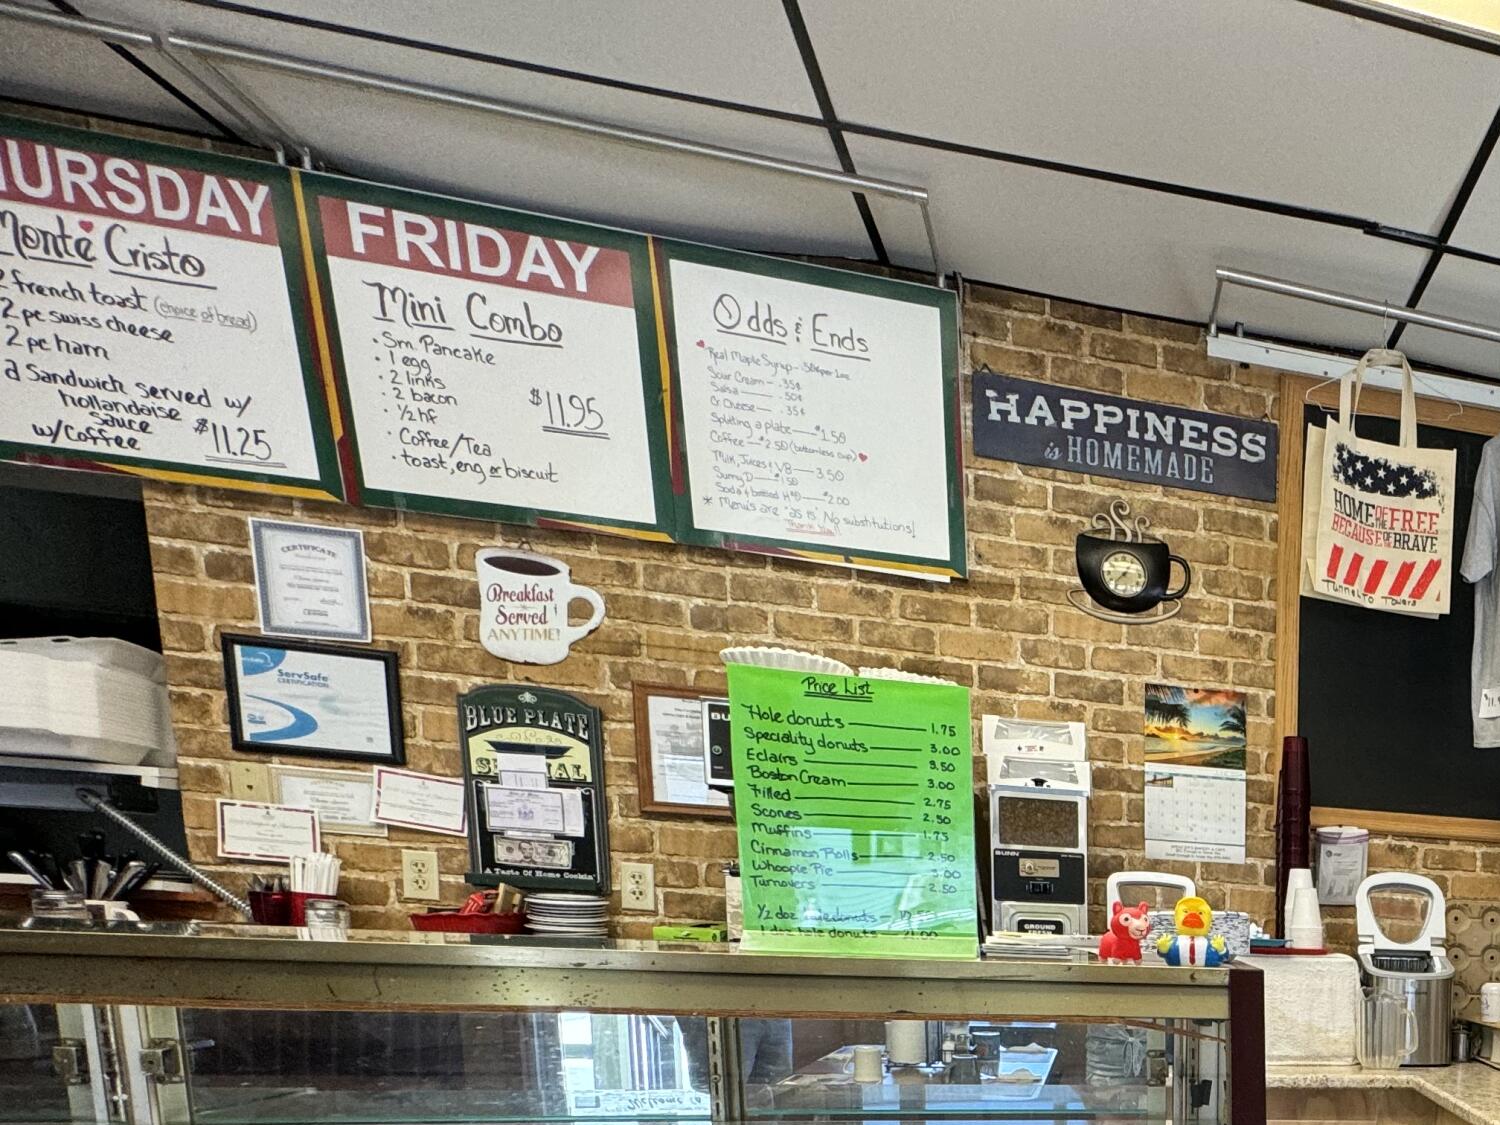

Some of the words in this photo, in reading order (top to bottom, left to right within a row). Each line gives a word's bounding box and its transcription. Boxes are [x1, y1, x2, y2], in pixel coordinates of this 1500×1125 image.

[0, 139, 271, 236] URSDAY
[105, 223, 206, 278] Cristo
[346, 201, 600, 293] FRIDAY
[11, 270, 85, 303] french
[90, 282, 148, 311] toast
[1, 299, 17, 319] 2
[49, 310, 103, 330] swiss
[105, 317, 175, 344] cheese
[362, 280, 446, 327] Mini
[466, 292, 564, 342] Combo
[713, 293, 788, 338] Odds
[811, 313, 870, 353] Ends
[6, 325, 23, 347] 2
[26, 334, 51, 354] pc
[54, 333, 110, 361] ham
[419, 335, 496, 366] Pancake
[401, 355, 432, 376] egg
[708, 366, 731, 380] Sour
[735, 371, 765, 385] Cream
[731, 350, 761, 367] Maple
[761, 354, 792, 376] Syrup
[5, 360, 21, 381] a
[25, 362, 129, 396] Sandwich
[135, 382, 212, 408] served
[224, 395, 252, 417] w/
[390, 369, 403, 385] 2
[405, 370, 446, 390] links
[710, 382, 738, 395] Salsa
[59, 389, 182, 421] hollandaise
[392, 387, 405, 401] 2
[410, 388, 458, 406] bacon
[528, 388, 604, 431] $11.95
[93, 412, 153, 435] sauce
[764, 421, 792, 434] plate
[985, 389, 1267, 463] HAPPINESS
[193, 419, 272, 461] $11.25
[710, 430, 744, 446] Coffee
[457, 459, 487, 484] eng
[489, 465, 502, 478] or
[505, 459, 559, 483] biscuit
[1044, 441, 1062, 461] is
[1067, 435, 1214, 484] HOMEMADE
[1333, 488, 1376, 527] HOME
[1375, 505, 1389, 519] OF
[1388, 508, 1440, 535] FREE
[1331, 513, 1383, 547] BECAUSE
[1393, 533, 1438, 553] BRAVE
[486, 582, 556, 603] Breakfast
[495, 605, 548, 626] Served
[487, 626, 562, 642] ANYTIME!
[277, 668, 329, 683] ServSafe
[802, 677, 838, 696] Price
[842, 678, 875, 695] List
[464, 704, 518, 732] BLUE
[523, 709, 590, 741] PLATE
[741, 703, 784, 724] Hole
[786, 705, 846, 729] donuts
[931, 723, 957, 738] 1.75
[745, 727, 814, 756] Speciality
[817, 733, 869, 753] donuts
[930, 743, 961, 757] 3.00
[747, 748, 799, 766] Eclairs
[929, 760, 956, 773] 3.50
[747, 764, 798, 784] Boston
[799, 769, 847, 788] Cream
[927, 778, 955, 792] 3.00
[747, 784, 791, 802] Filled
[923, 797, 952, 810] 2.75
[751, 803, 802, 820] Scones
[923, 813, 952, 826] 2.50
[752, 822, 812, 840] Muffins
[923, 831, 950, 843] 1.75
[752, 859, 809, 876] Whoopie
[811, 862, 834, 877] Pie
[928, 852, 956, 863] 2.50
[750, 874, 816, 891] Turnovers
[928, 883, 958, 895] 2.50
[775, 905, 797, 920] doz
[1023, 923, 1056, 931] GROUND
